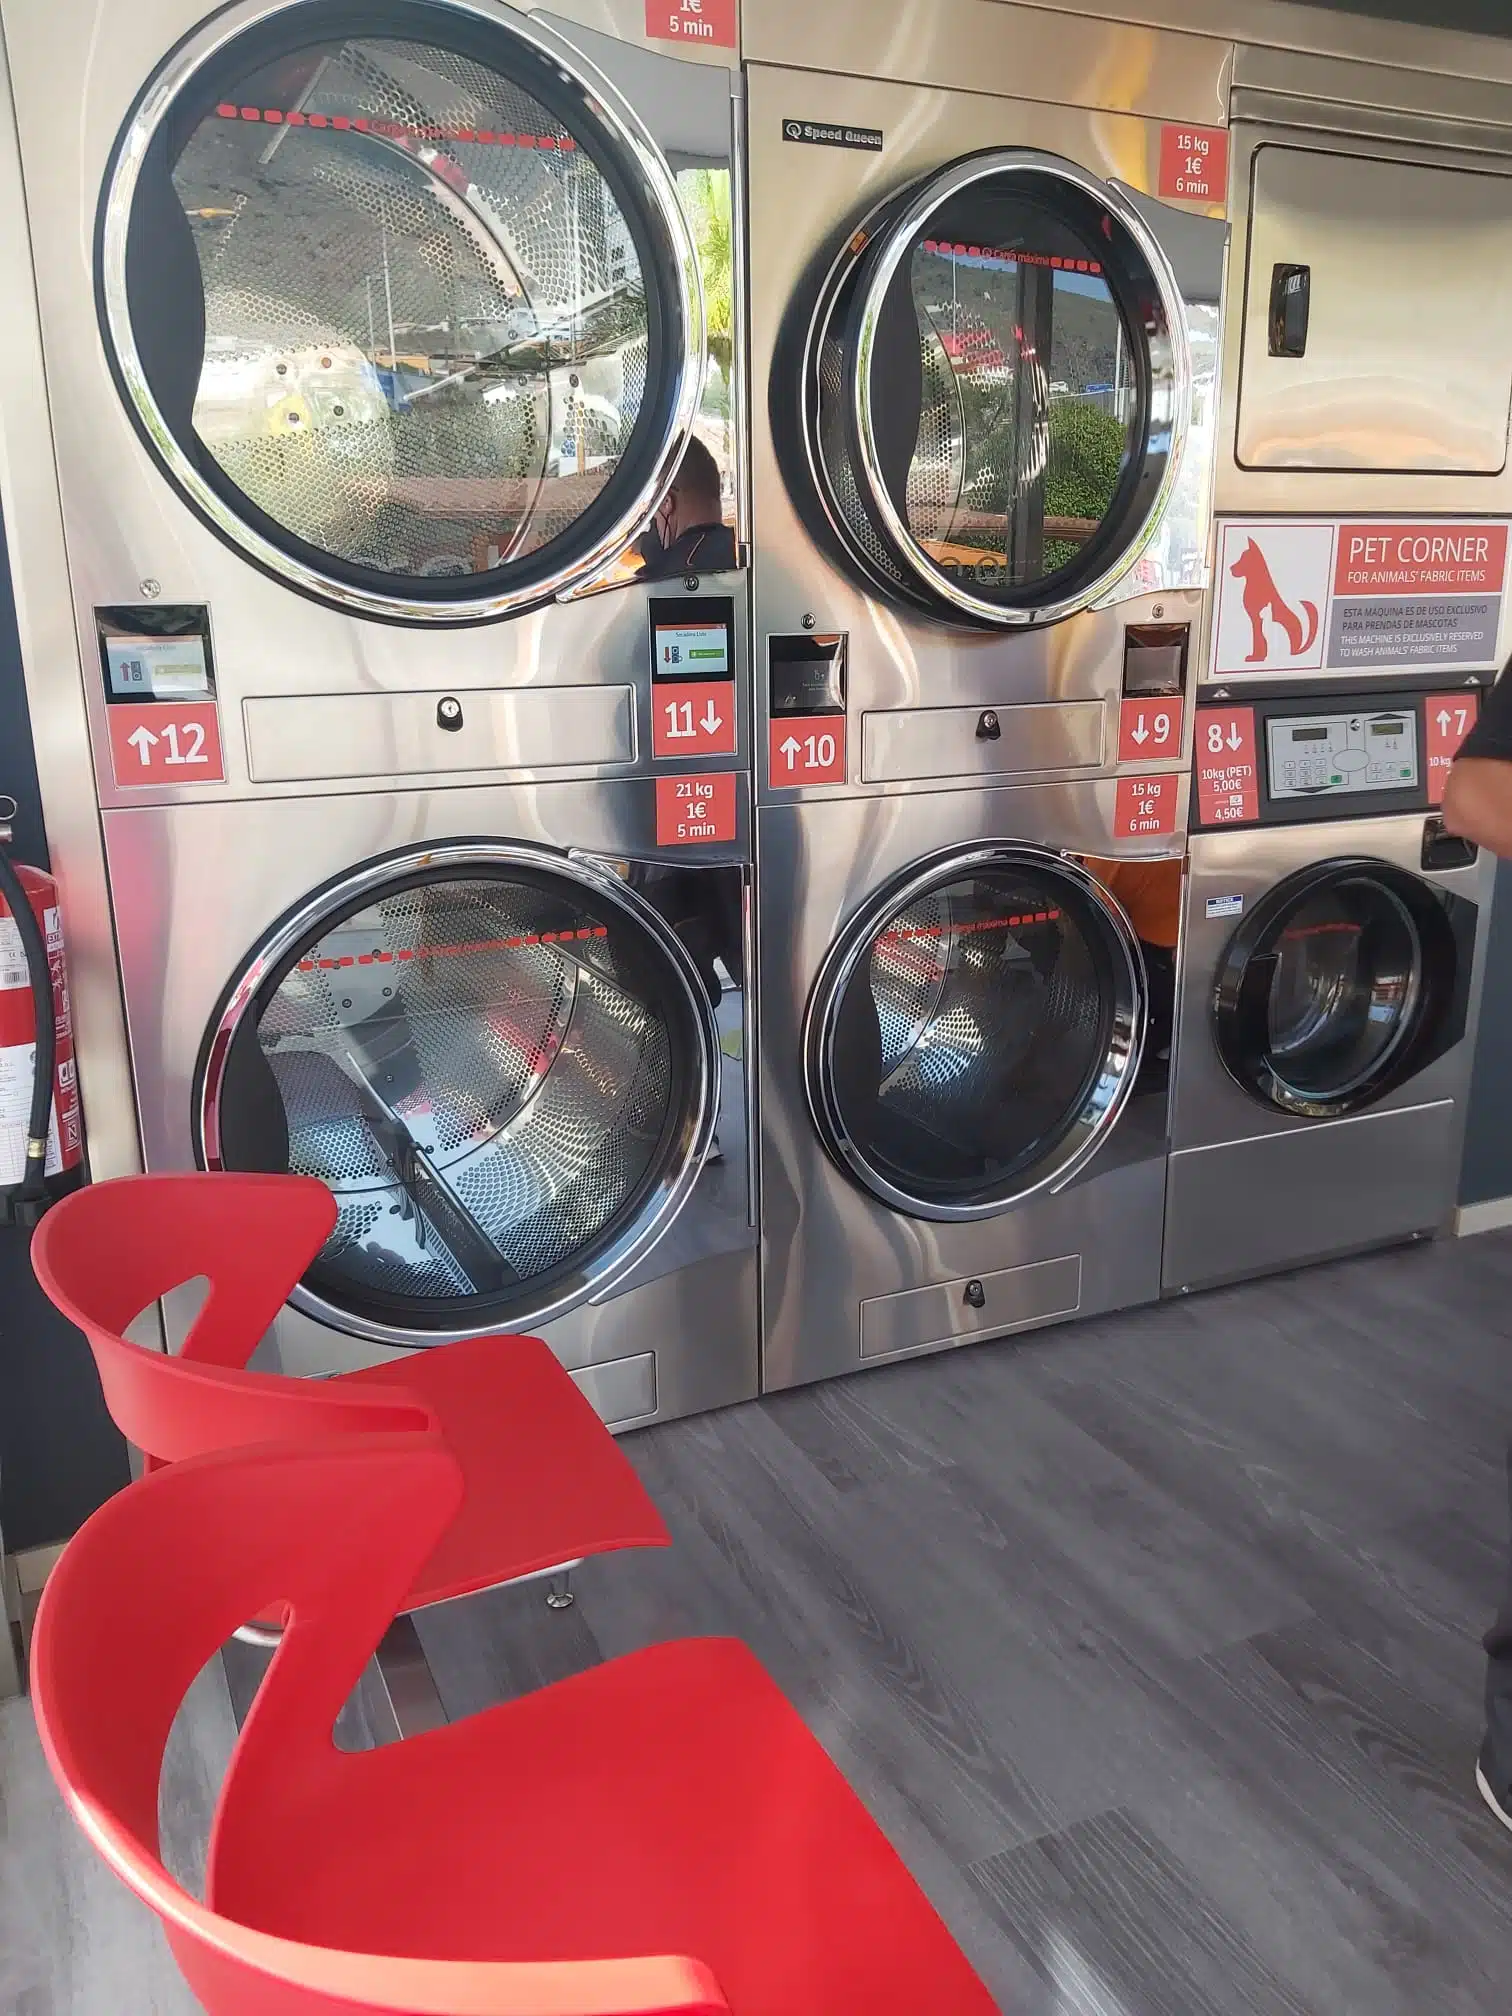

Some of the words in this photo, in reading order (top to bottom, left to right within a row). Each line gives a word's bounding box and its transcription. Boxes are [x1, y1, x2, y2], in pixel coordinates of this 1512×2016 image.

[670, 16, 680, 32] 5
[684, 18, 713, 37] min
[804, 126, 842, 140] Speed
[845, 131, 882, 144] Queen
[1177, 134, 1191, 150] 15
[1194, 136, 1208, 156] kg
[1185, 156, 1202, 174] 1€
[1176, 178, 1184, 192] 6
[1186, 180, 1208, 194] min
[1350, 537, 1392, 563] PET
[1398, 537, 1488, 563] CORNER
[1348, 571, 1368, 583] FOR
[1420, 570, 1454, 582] FABRIC
[1456, 570, 1486, 582] ITEMS
[1344, 608, 1362, 618] ESTA
[1406, 606, 1414, 616] ES
[1416, 606, 1426, 616] DE
[1428, 606, 1444, 615] USO
[1446, 604, 1488, 614] EXCLUSIVO
[1342, 622, 1362, 630] PARA
[1365, 620, 1402, 630] PRENDAS
[1404, 620, 1414, 628] DE
[1415, 618, 1458, 628] MASCOTAS
[1341, 636, 1356, 645] THIS
[1358, 634, 1393, 644] MACHINE
[1394, 634, 1400, 643] IS
[1402, 632, 1448, 643] EXCLUSIVELY
[1450, 631, 1484, 641] RESERVED
[1340, 648, 1350, 657] TO
[1352, 648, 1374, 656] WASH
[1410, 645, 1435, 654] FABRIC
[1436, 644, 1458, 653] ITEMS
[664, 701, 696, 738] 11
[1454, 710, 1467, 735] 7
[1154, 713, 1170, 744] 9
[161, 722, 208, 764] 12
[1208, 724, 1224, 752] 8
[804, 734, 836, 768] 10
[1428, 757, 1439, 766] 10
[1202, 768, 1224, 780] 10kg
[1226, 765, 1252, 778] (PET)
[676, 783, 692, 798] 21
[696, 782, 713, 798] kg
[1132, 783, 1144, 796] 15
[1148, 782, 1160, 797] kg
[1214, 779, 1242, 793] 5,00€
[686, 802, 706, 818] 1€
[1138, 800, 1154, 814] 1€
[1215, 807, 1244, 820] 4,50€
[678, 824, 686, 838] 5
[690, 822, 715, 836] min
[1130, 819, 1136, 831] 6
[1140, 818, 1160, 830] min
